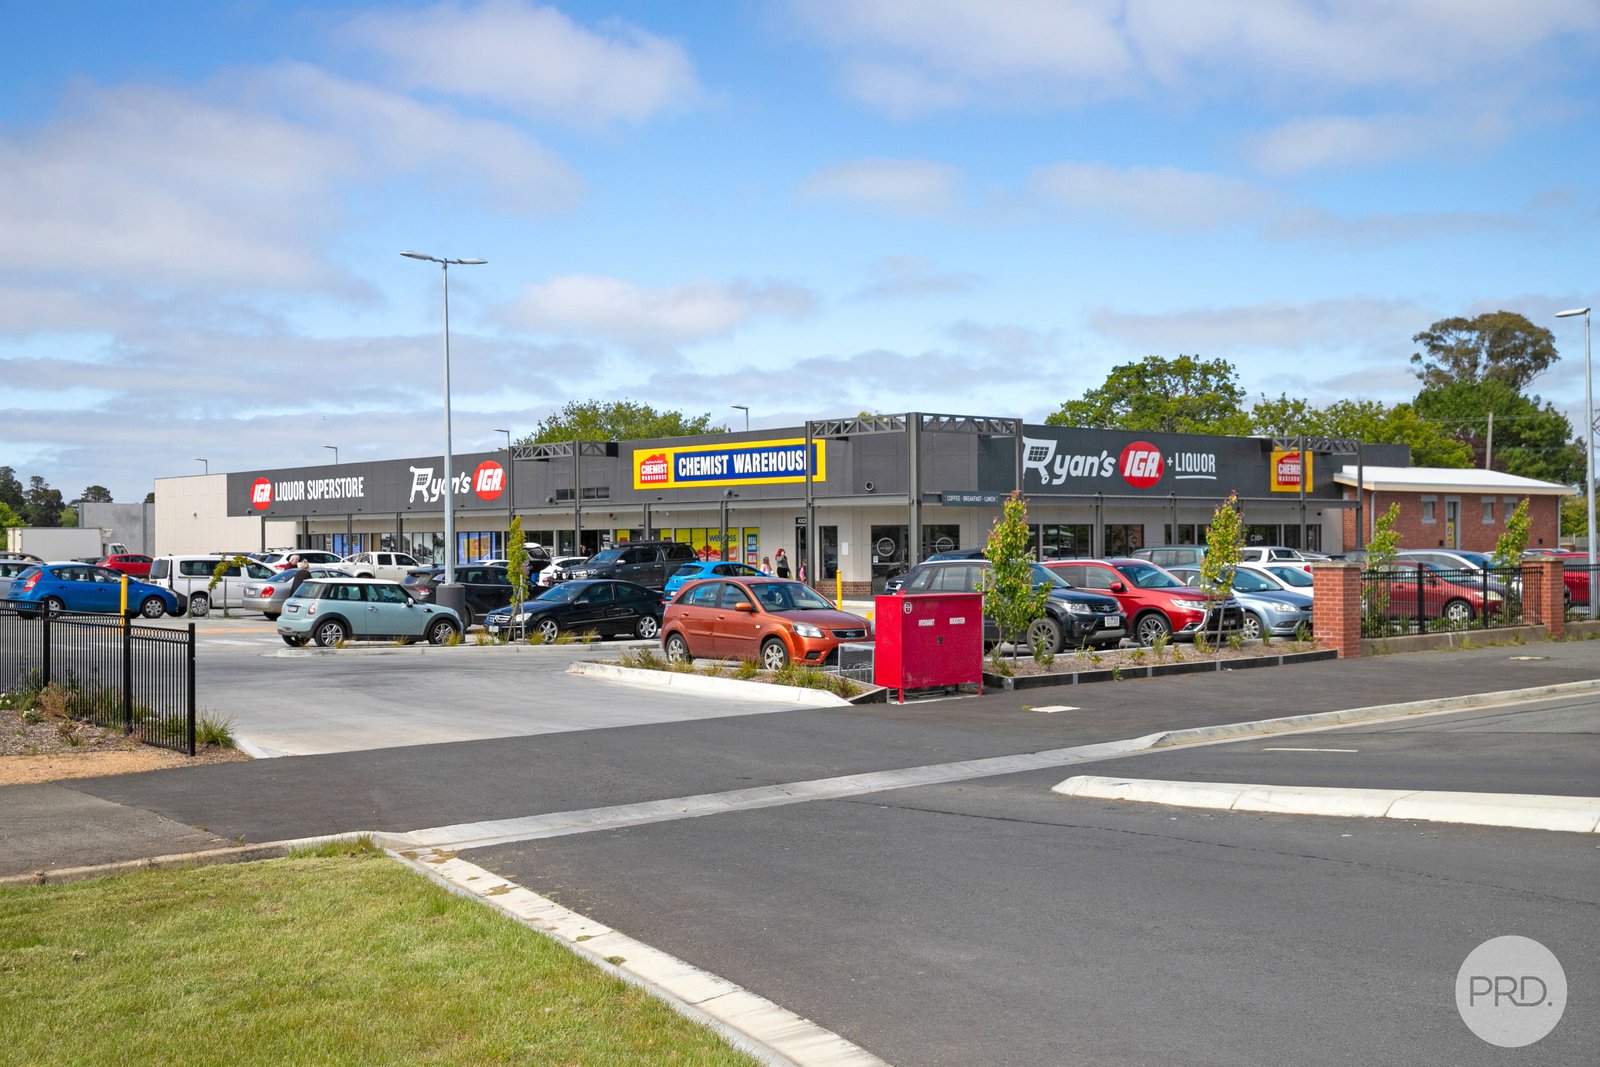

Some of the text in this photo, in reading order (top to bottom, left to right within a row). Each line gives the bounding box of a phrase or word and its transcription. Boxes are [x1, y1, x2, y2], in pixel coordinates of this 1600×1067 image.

[641, 464, 668, 475] CHEMIST
[678, 450, 807, 477] CHEMIST WAREHOUS
[1022, 435, 1117, 485] Ryan's
[1123, 450, 1161, 478] IGA
[1175, 452, 1216, 473] LIQUOR
[1278, 463, 1301, 475] CHEMIS
[252, 477, 365, 503] IGA LIQUOR SUPERSTORE
[475, 467, 503, 492] IGA
